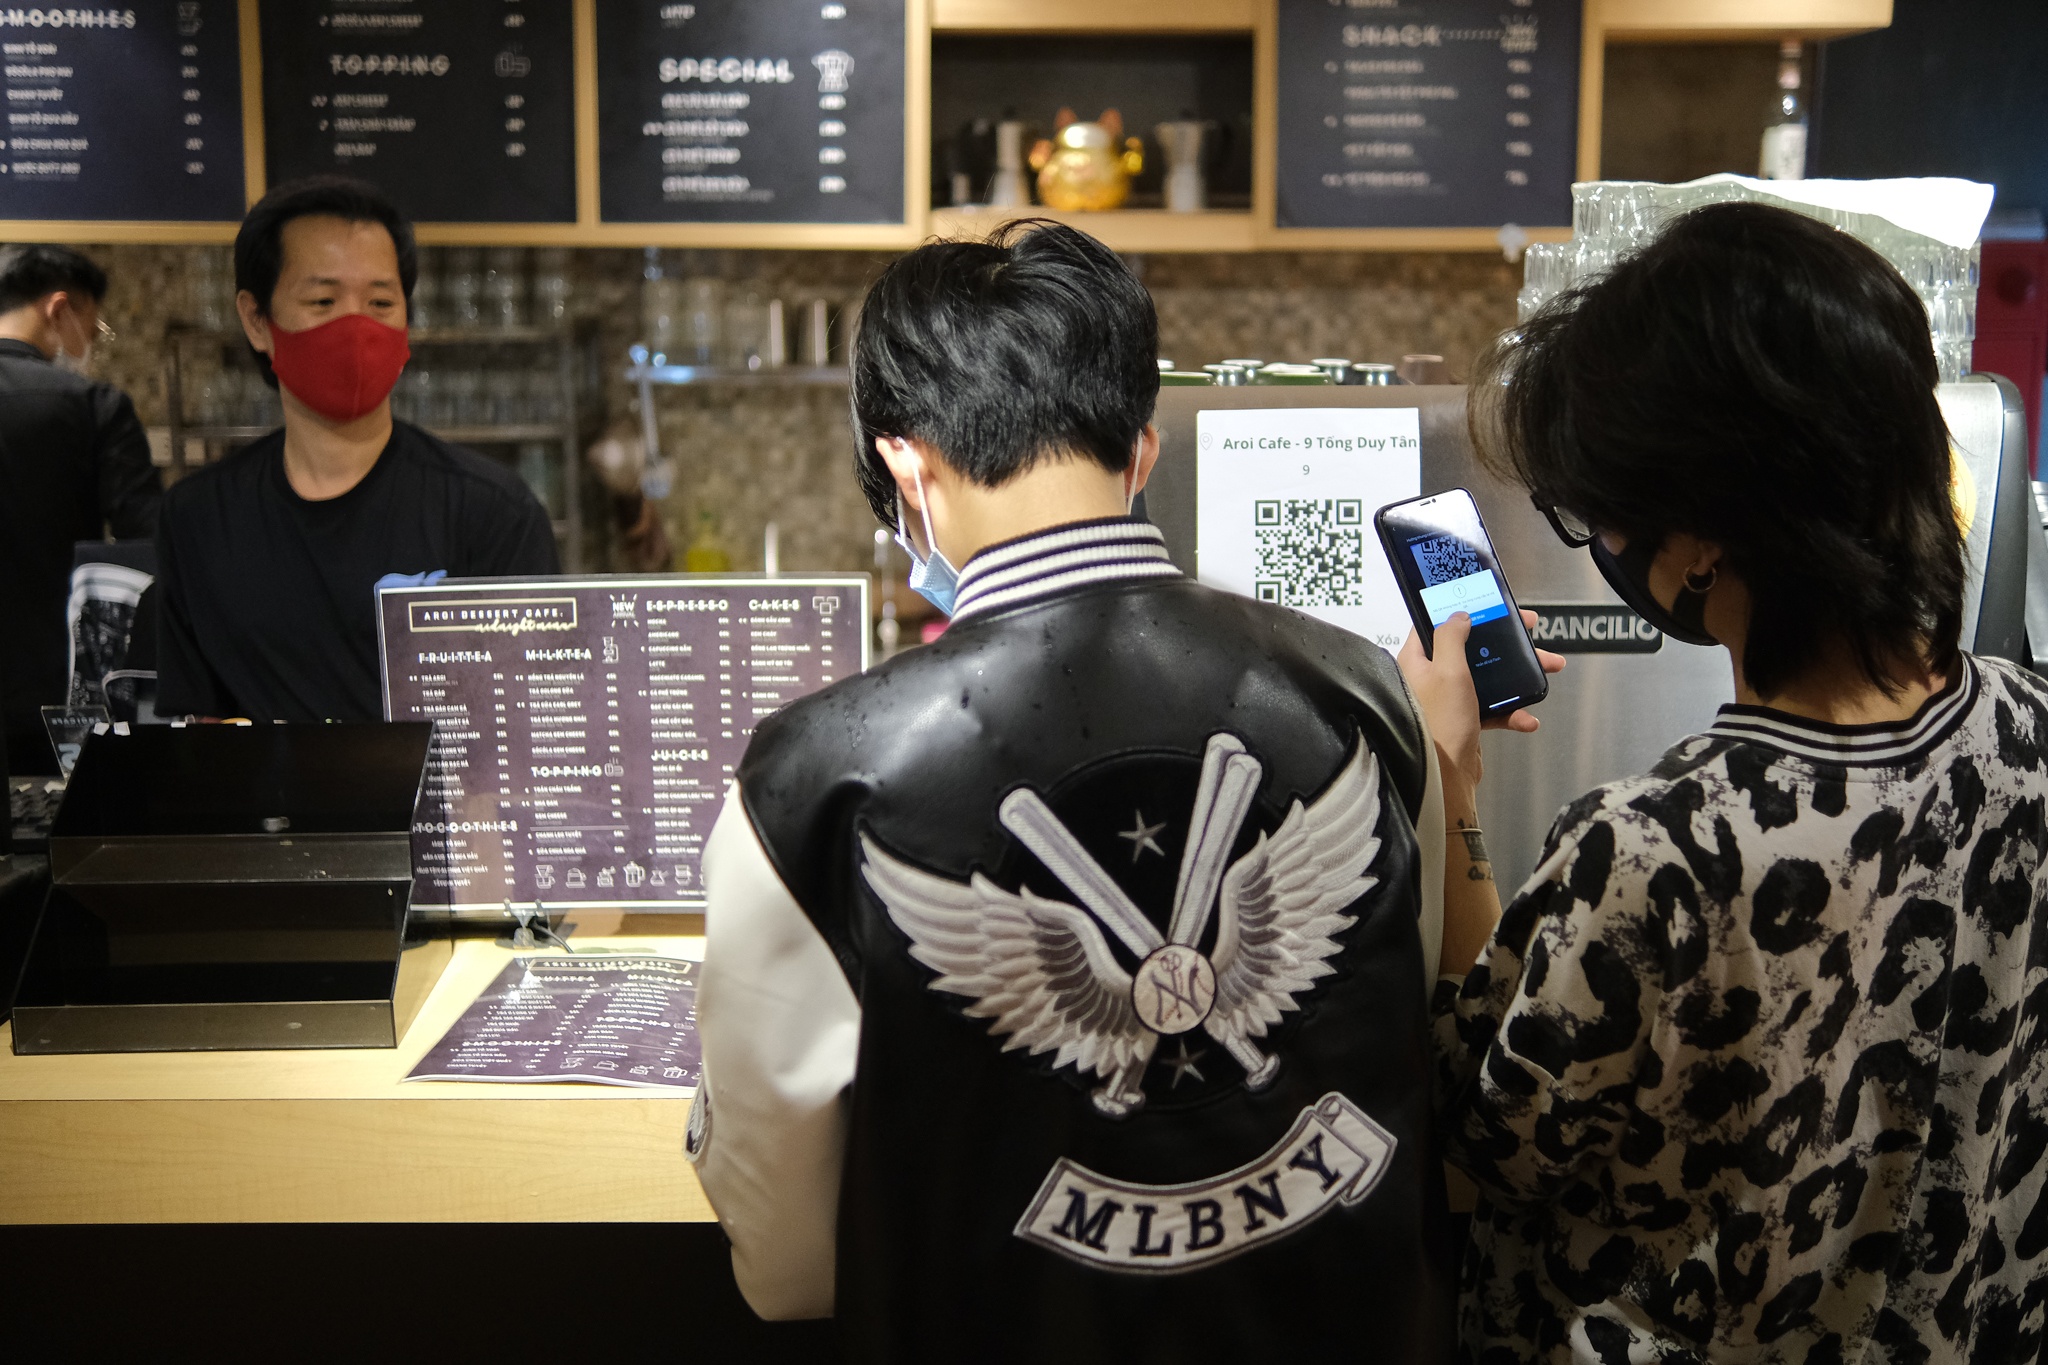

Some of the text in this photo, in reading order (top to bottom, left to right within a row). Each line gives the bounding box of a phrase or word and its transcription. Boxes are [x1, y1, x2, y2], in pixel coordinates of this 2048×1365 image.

[659, 57, 795, 83] SPECIAL
[1223, 437, 1254, 450] Aroi
[1258, 437, 1291, 450] Cafe
[1304, 437, 1312, 450] 9
[1357, 437, 1386, 451] Duy
[1390, 435, 1417, 448] Tân
[1302, 464, 1310, 475] 9
[612, 602, 634, 612] NEW
[424, 610, 454, 621] AROI
[460, 609, 518, 620] DESSERT
[1532, 615, 1660, 641] RANCILIO
[1377, 633, 1400, 645] Xóa
[1051, 1132, 1340, 1257] MLBNY
